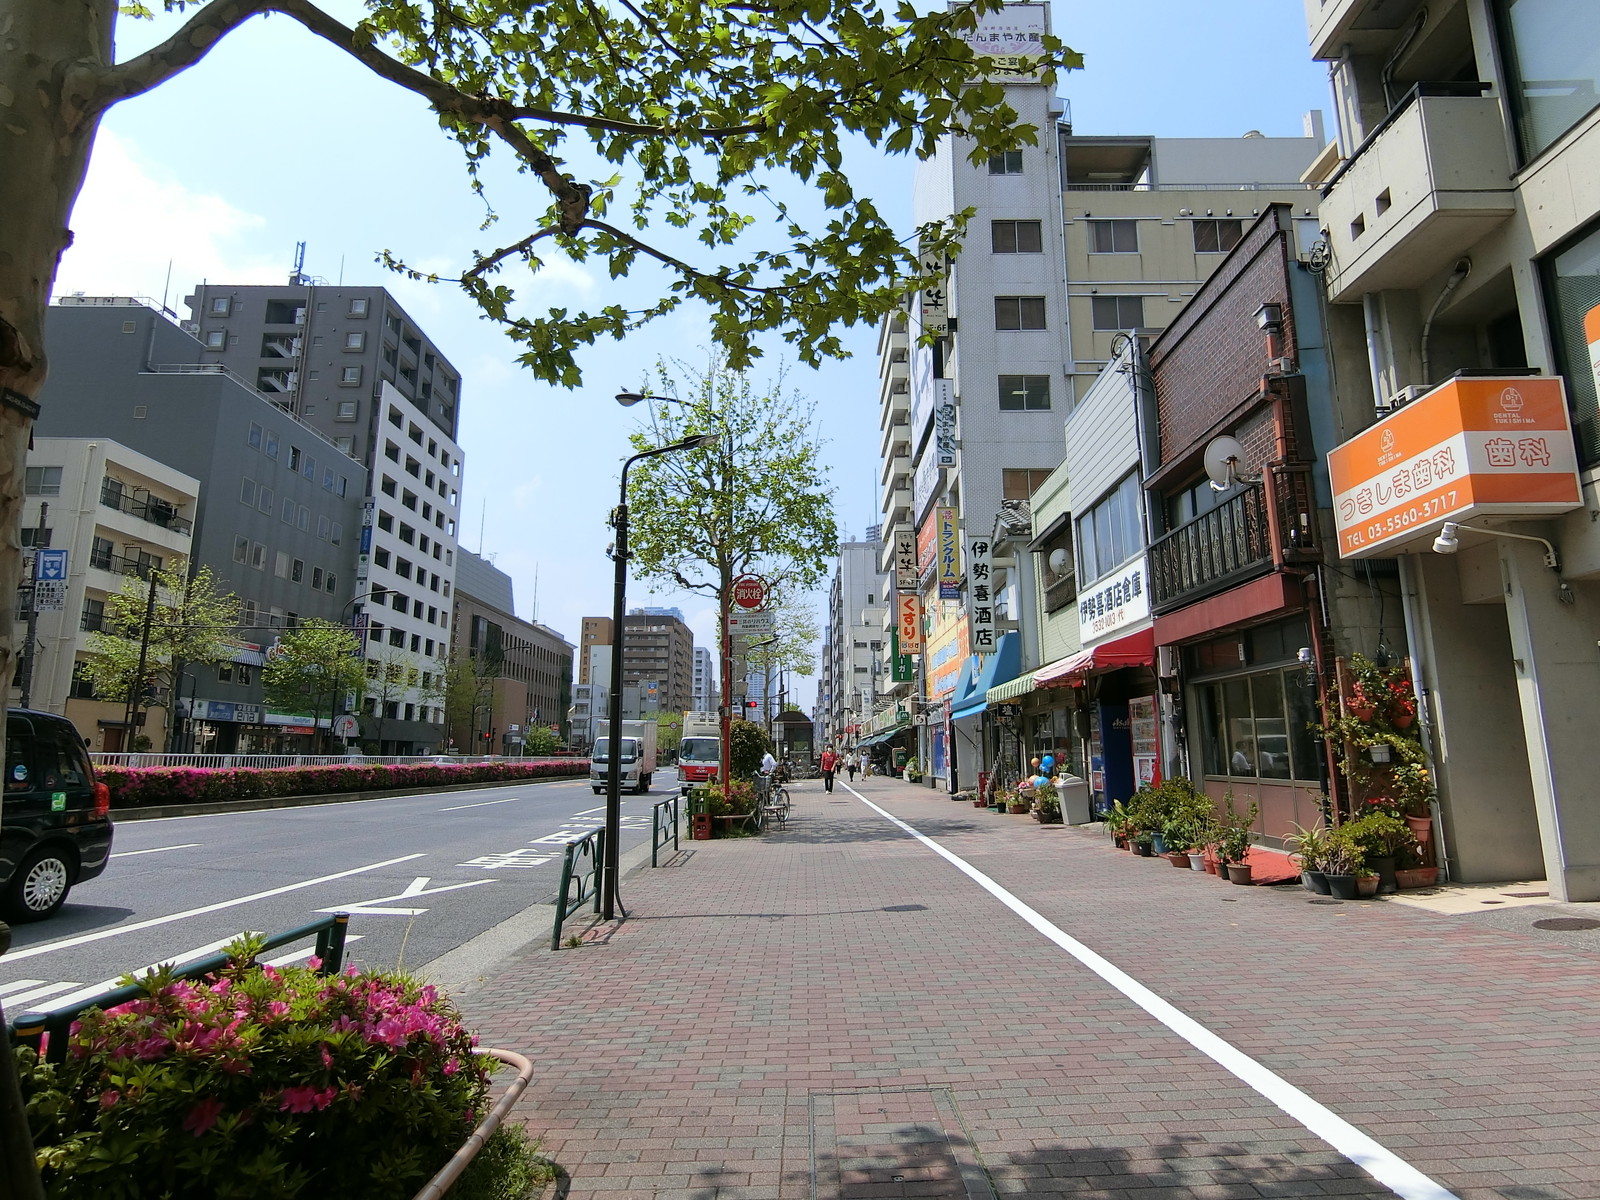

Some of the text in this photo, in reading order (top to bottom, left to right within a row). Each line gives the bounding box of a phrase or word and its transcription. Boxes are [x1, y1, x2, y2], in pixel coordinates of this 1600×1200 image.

[1484, 437, 1550, 467] 歯科
[1340, 446, 1455, 521] つきしま歯科
[1347, 490, 1457, 548] TEL 03-5560-3717
[942, 521, 956, 578] トランクルーム
[737, 588, 761, 599] 消火栓
[903, 598, 915, 640] くすり
[971, 541, 993, 646] 伊勢喜酒店
[1080, 570, 1142, 625] 伊勢喜酒店倉庫
